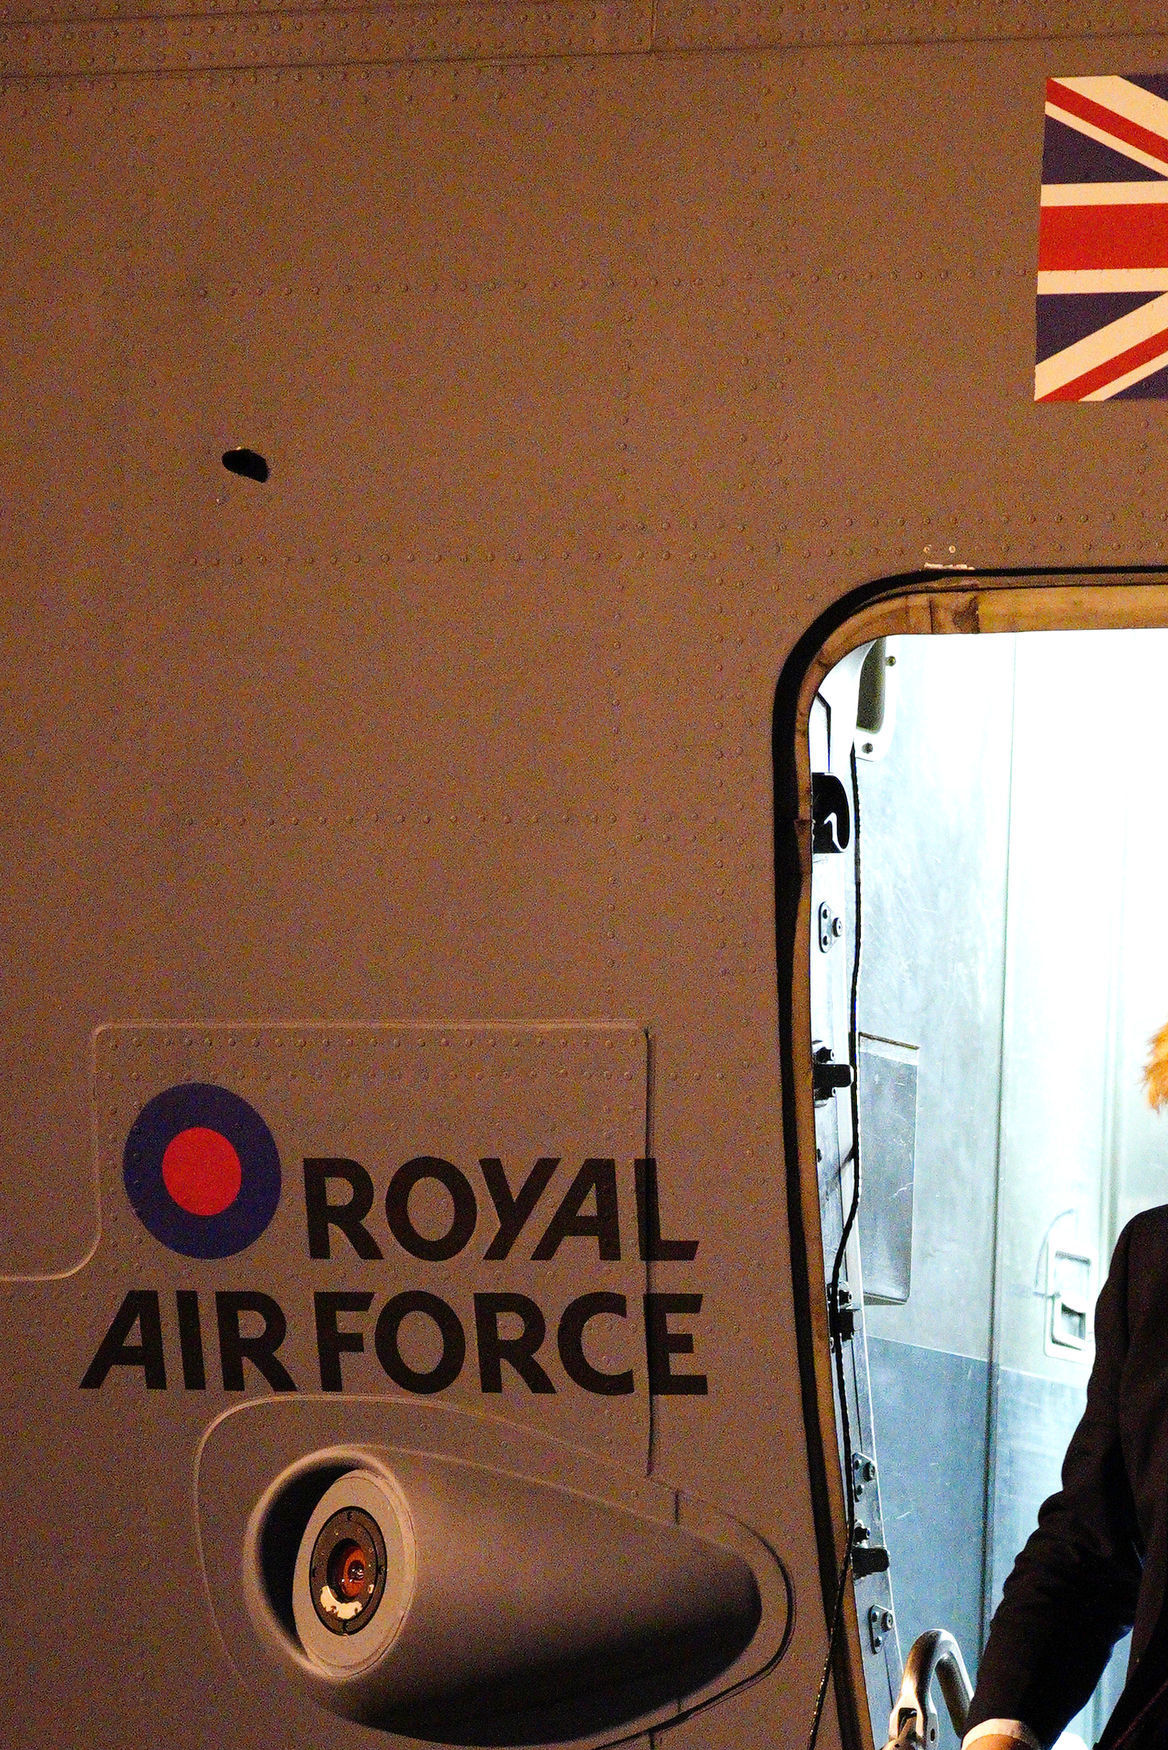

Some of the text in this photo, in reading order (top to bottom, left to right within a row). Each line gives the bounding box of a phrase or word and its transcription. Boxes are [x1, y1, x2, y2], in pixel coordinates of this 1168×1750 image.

[303, 1157, 698, 1261] ROYAL
[79, 1290, 708, 1396] AIR FORCE
